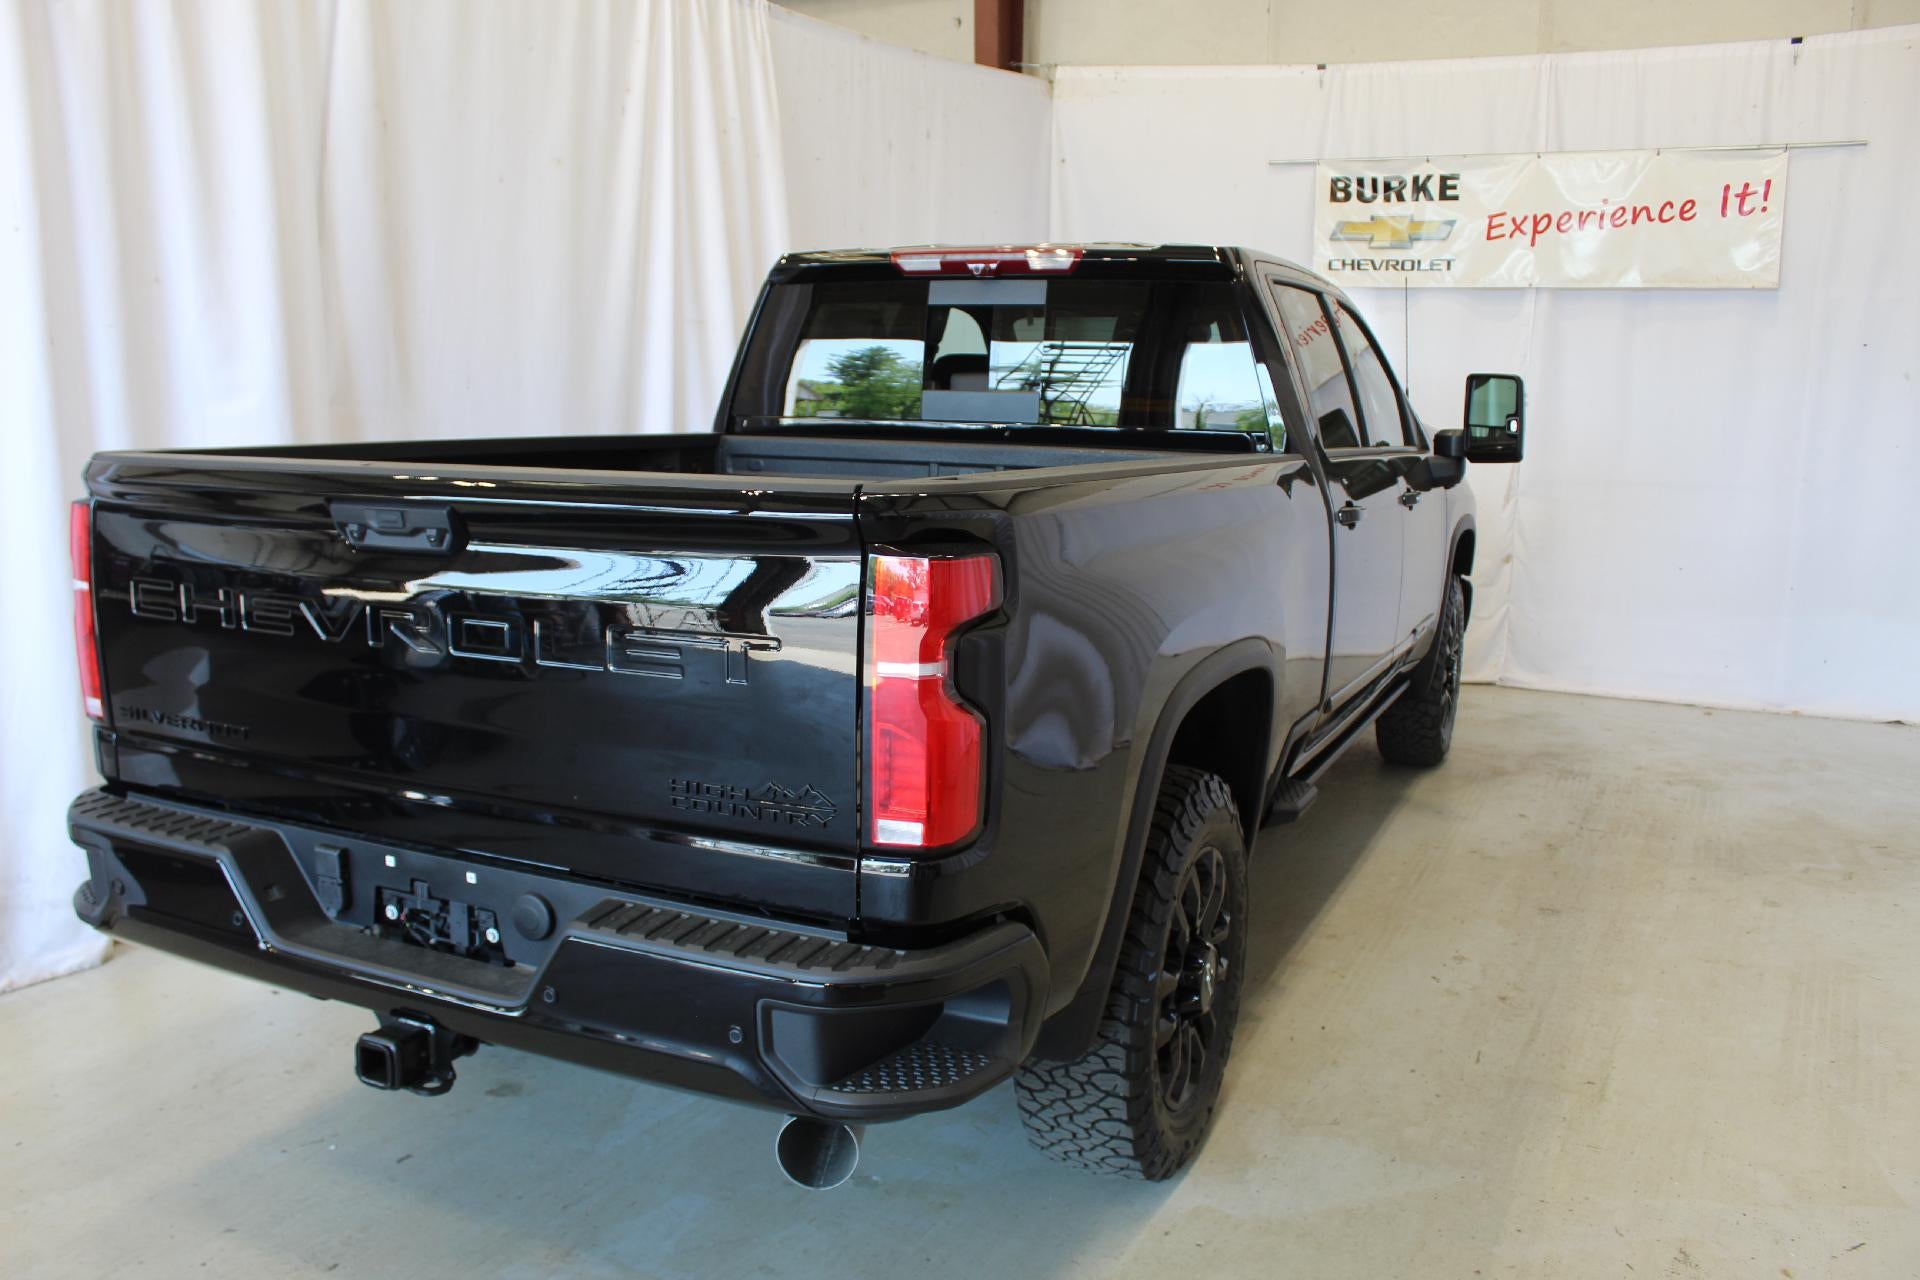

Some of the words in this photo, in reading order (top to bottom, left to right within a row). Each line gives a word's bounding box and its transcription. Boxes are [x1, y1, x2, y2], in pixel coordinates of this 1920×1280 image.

[1329, 173, 1460, 203] BURKE
[1486, 198, 1697, 247] Experience
[1720, 178, 1772, 218] It!
[1327, 258, 1456, 272] CHEVROLET
[129, 576, 783, 686] CHEVROLET
[669, 778, 750, 801] HIGH
[670, 795, 837, 829] COUNTRY
